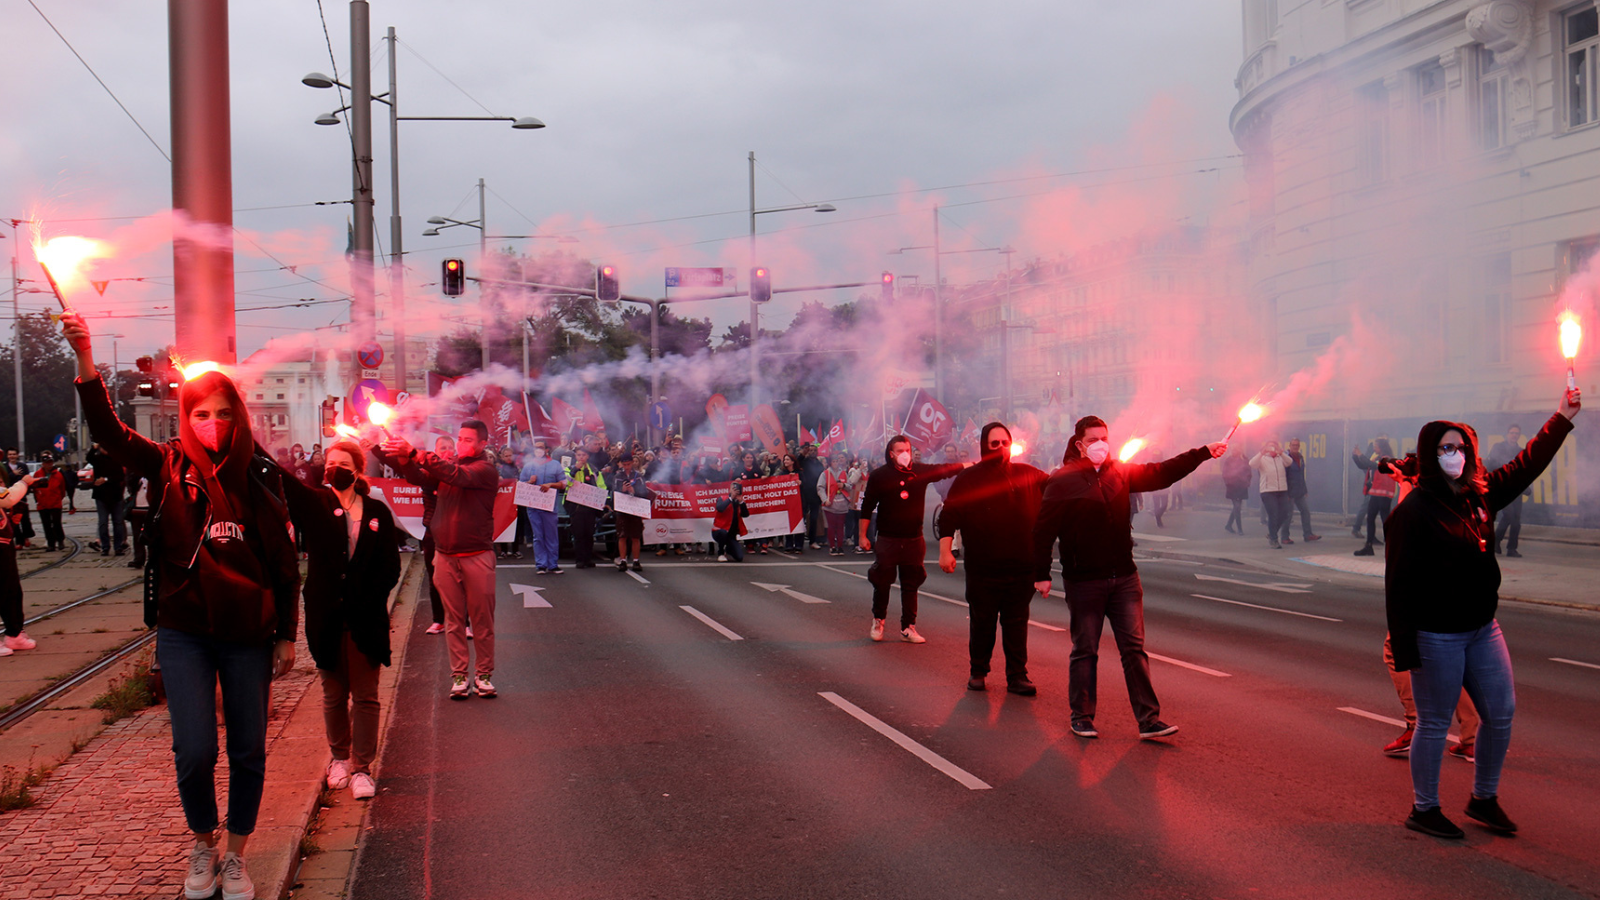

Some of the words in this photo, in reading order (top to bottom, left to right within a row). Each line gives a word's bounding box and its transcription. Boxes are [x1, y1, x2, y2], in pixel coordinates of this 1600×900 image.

[681, 272, 721, 284] Karlsplatz
[1309, 433, 1327, 459] 150
[393, 486, 417, 494] EURE
[497, 486, 513, 494] ALT
[709, 488, 730, 496] KANN
[754, 480, 799, 492] RECHNUNGE
[654, 490, 685, 500] PREISE
[697, 497, 717, 505] NICHT
[742, 493, 764, 501] CHEN,
[764, 490, 783, 499] HOLT
[783, 489, 799, 497] DAS
[412, 497, 424, 505] ME
[654, 499, 692, 510] RUNTER
[746, 499, 787, 509] ERREICHEN!
